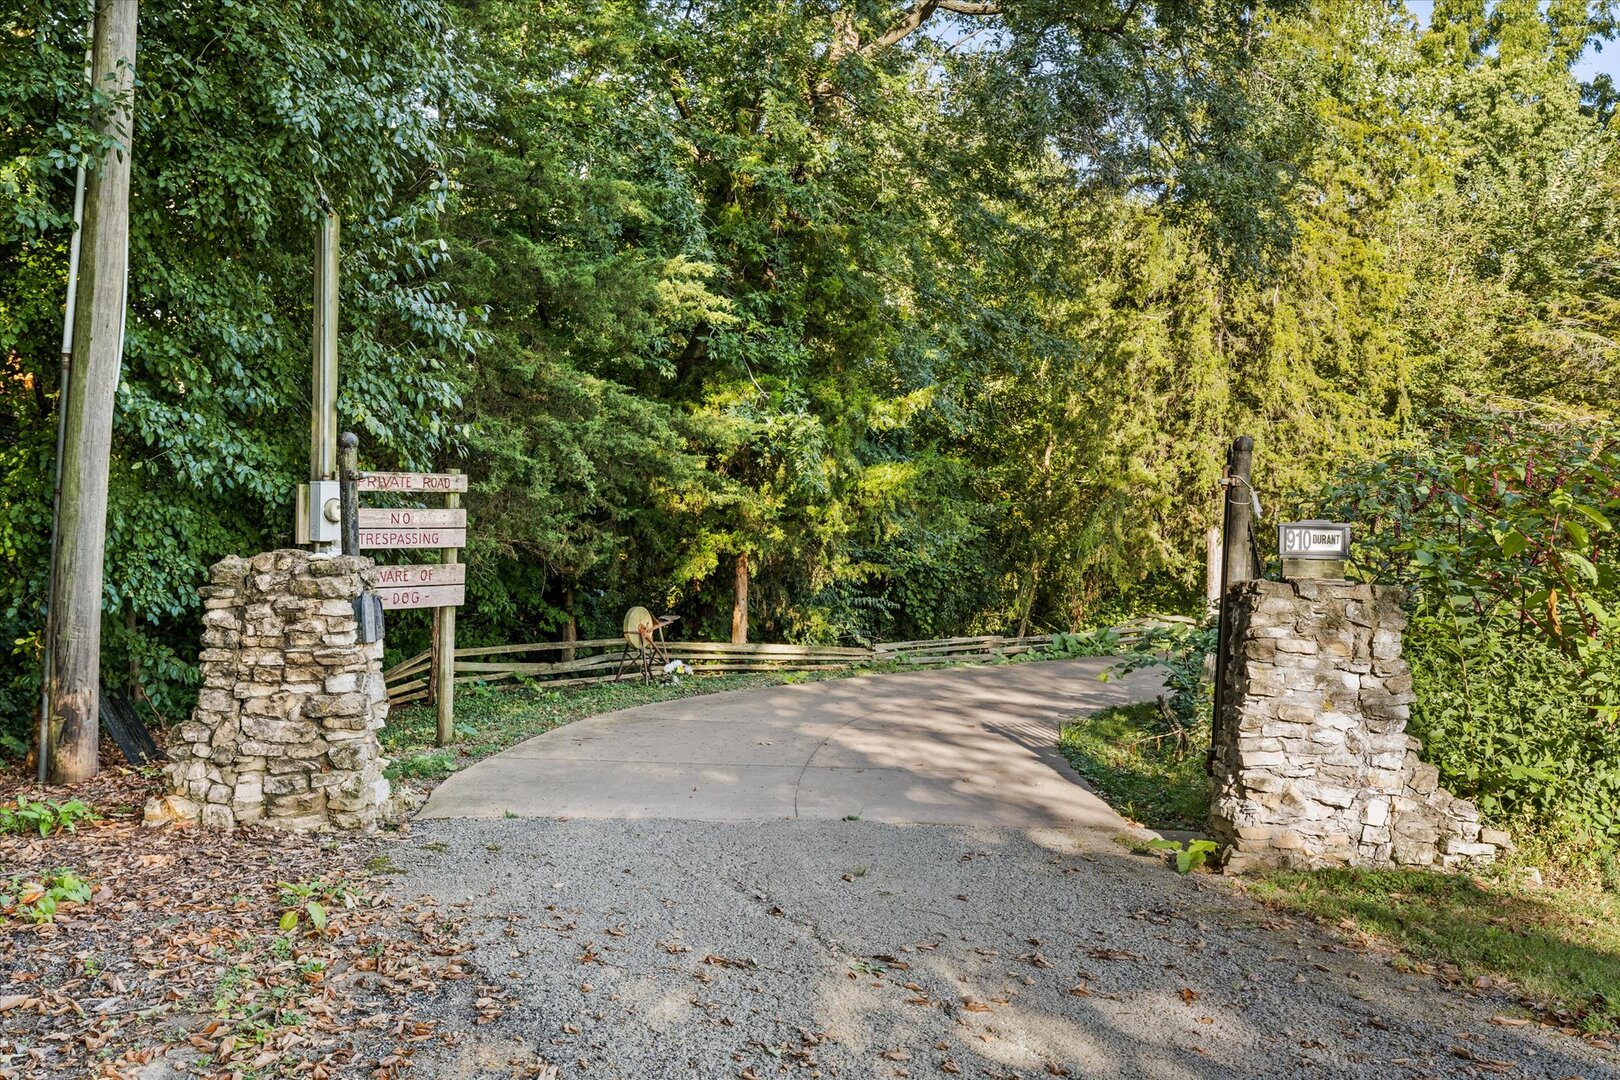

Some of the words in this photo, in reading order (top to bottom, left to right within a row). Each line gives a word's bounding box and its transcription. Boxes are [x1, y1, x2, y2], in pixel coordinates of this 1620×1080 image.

[357, 475, 412, 489] PRIVATE
[422, 477, 451, 489] ROAD
[390, 513, 411, 525] NO
[359, 532, 439, 545] TRESPASSING
[1286, 529, 1312, 551] 910
[1312, 534, 1341, 545] DURANT
[377, 570, 409, 583] WARE
[420, 569, 434, 581] OF
